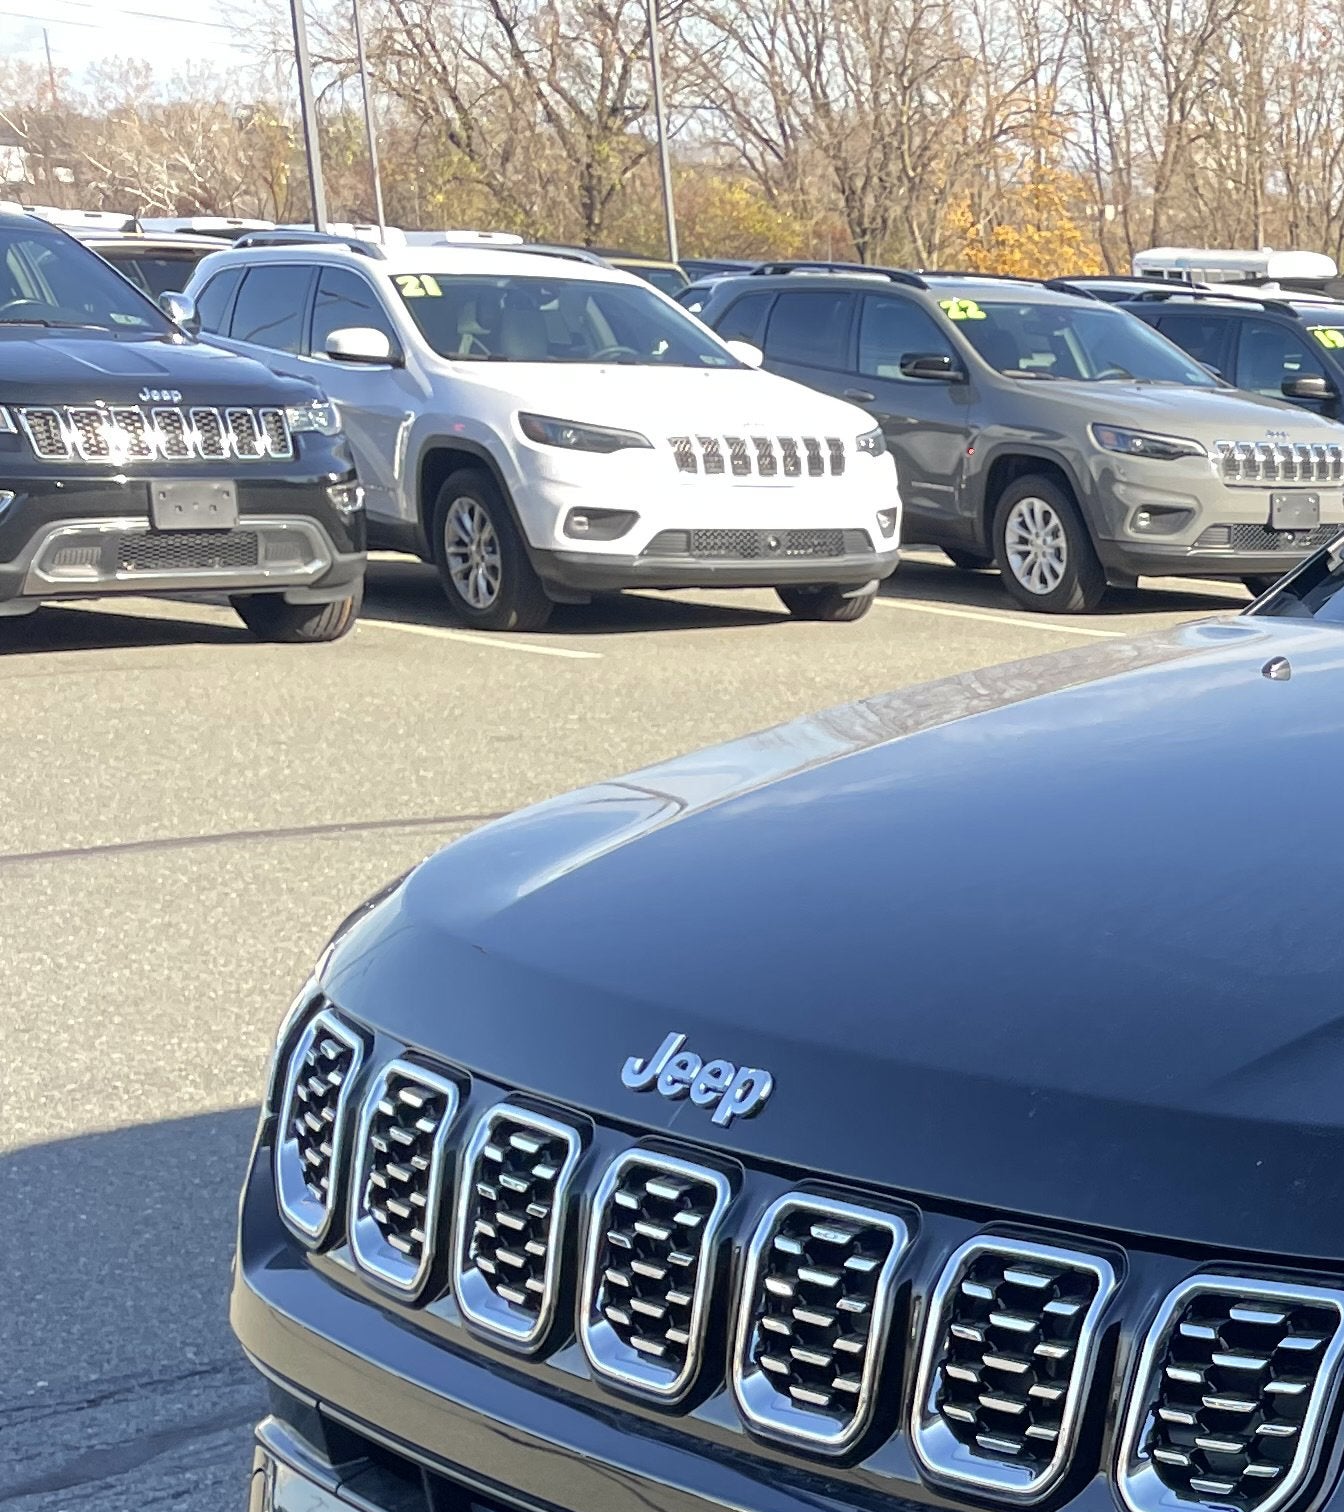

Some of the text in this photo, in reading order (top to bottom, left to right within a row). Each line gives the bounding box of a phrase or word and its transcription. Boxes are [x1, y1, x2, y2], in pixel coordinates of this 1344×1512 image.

[395, 275, 443, 297] 21
[939, 299, 987, 319] 22
[138, 386, 183, 404] Jeep
[621, 1031, 774, 1129] Jeep
